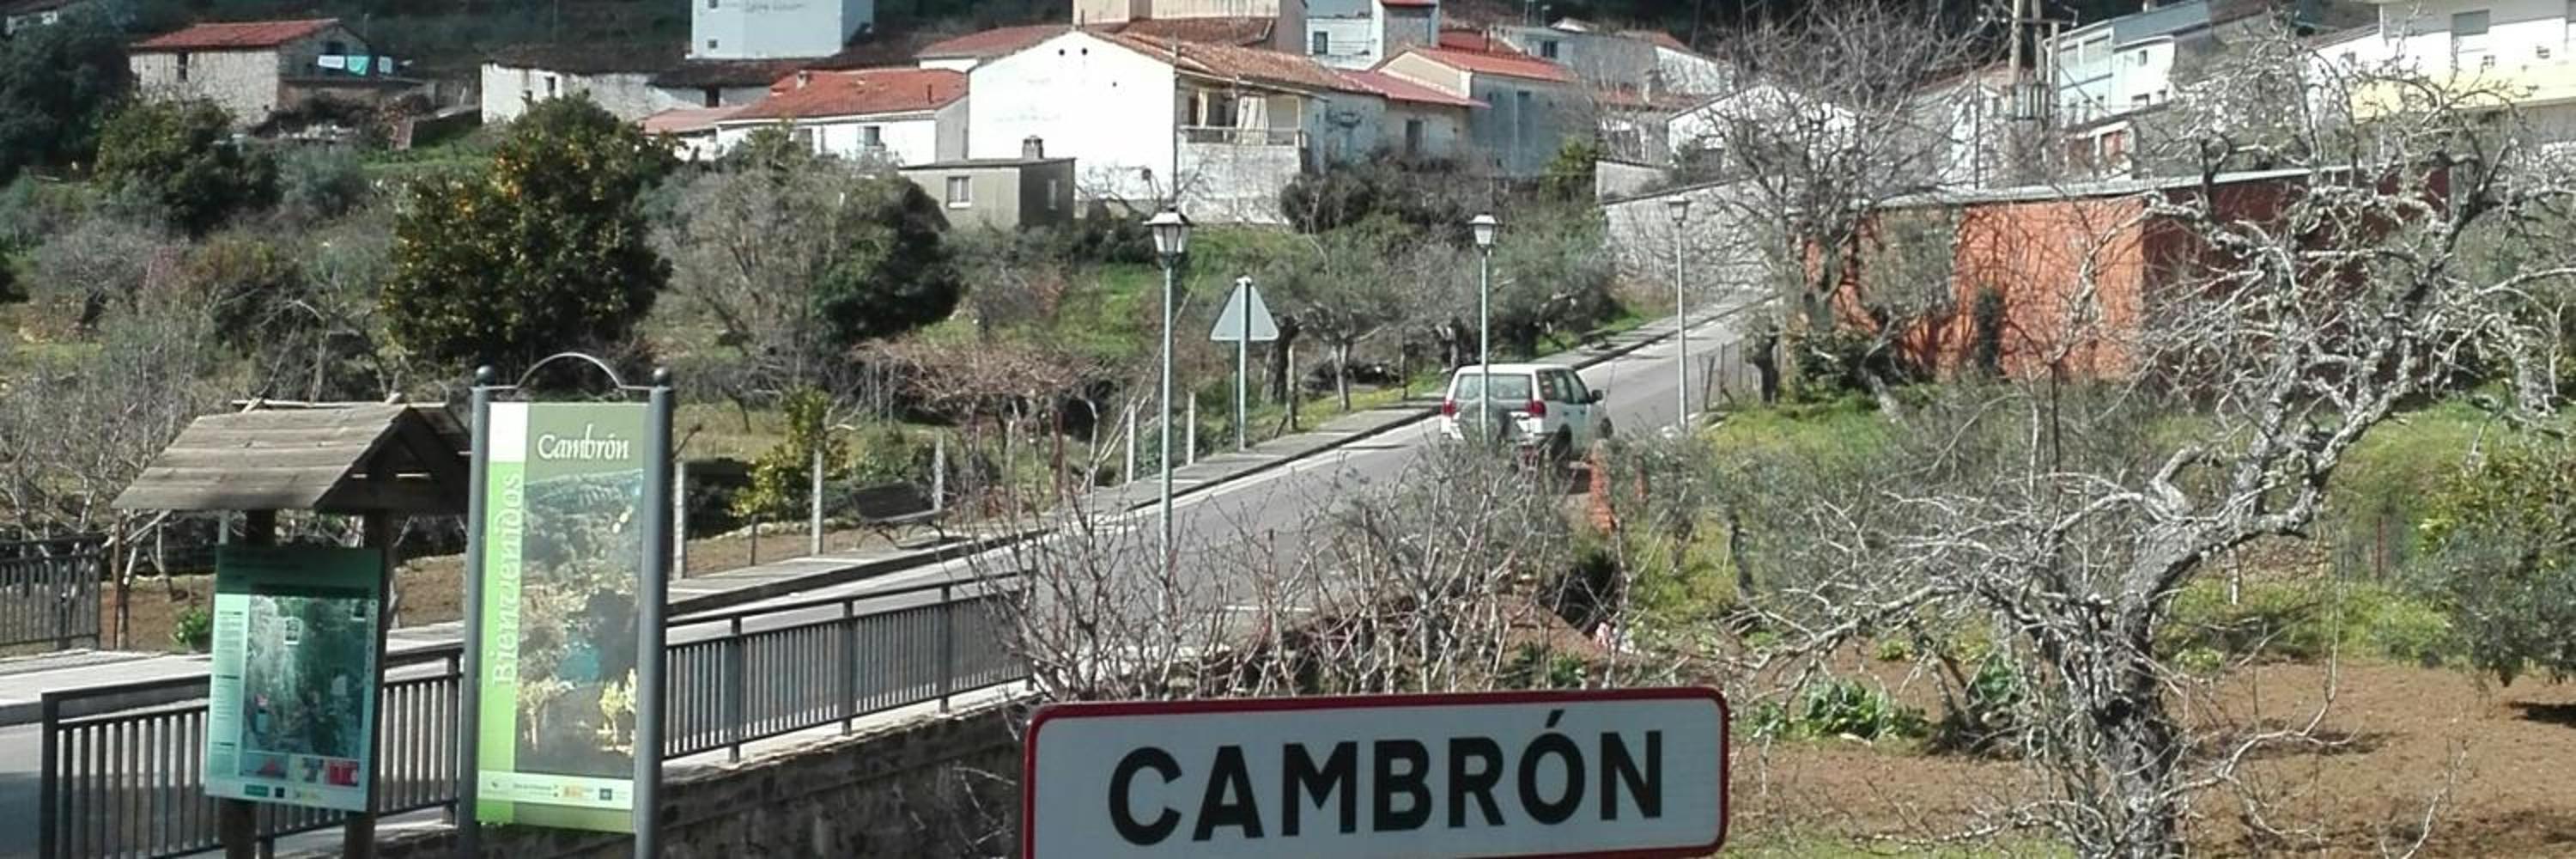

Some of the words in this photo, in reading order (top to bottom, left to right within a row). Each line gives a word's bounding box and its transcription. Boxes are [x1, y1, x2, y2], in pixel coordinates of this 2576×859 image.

[538, 423, 629, 460] Cambrón
[493, 473, 523, 685] Bienvenidos
[1109, 710, 1662, 846] CAMBRÓN
